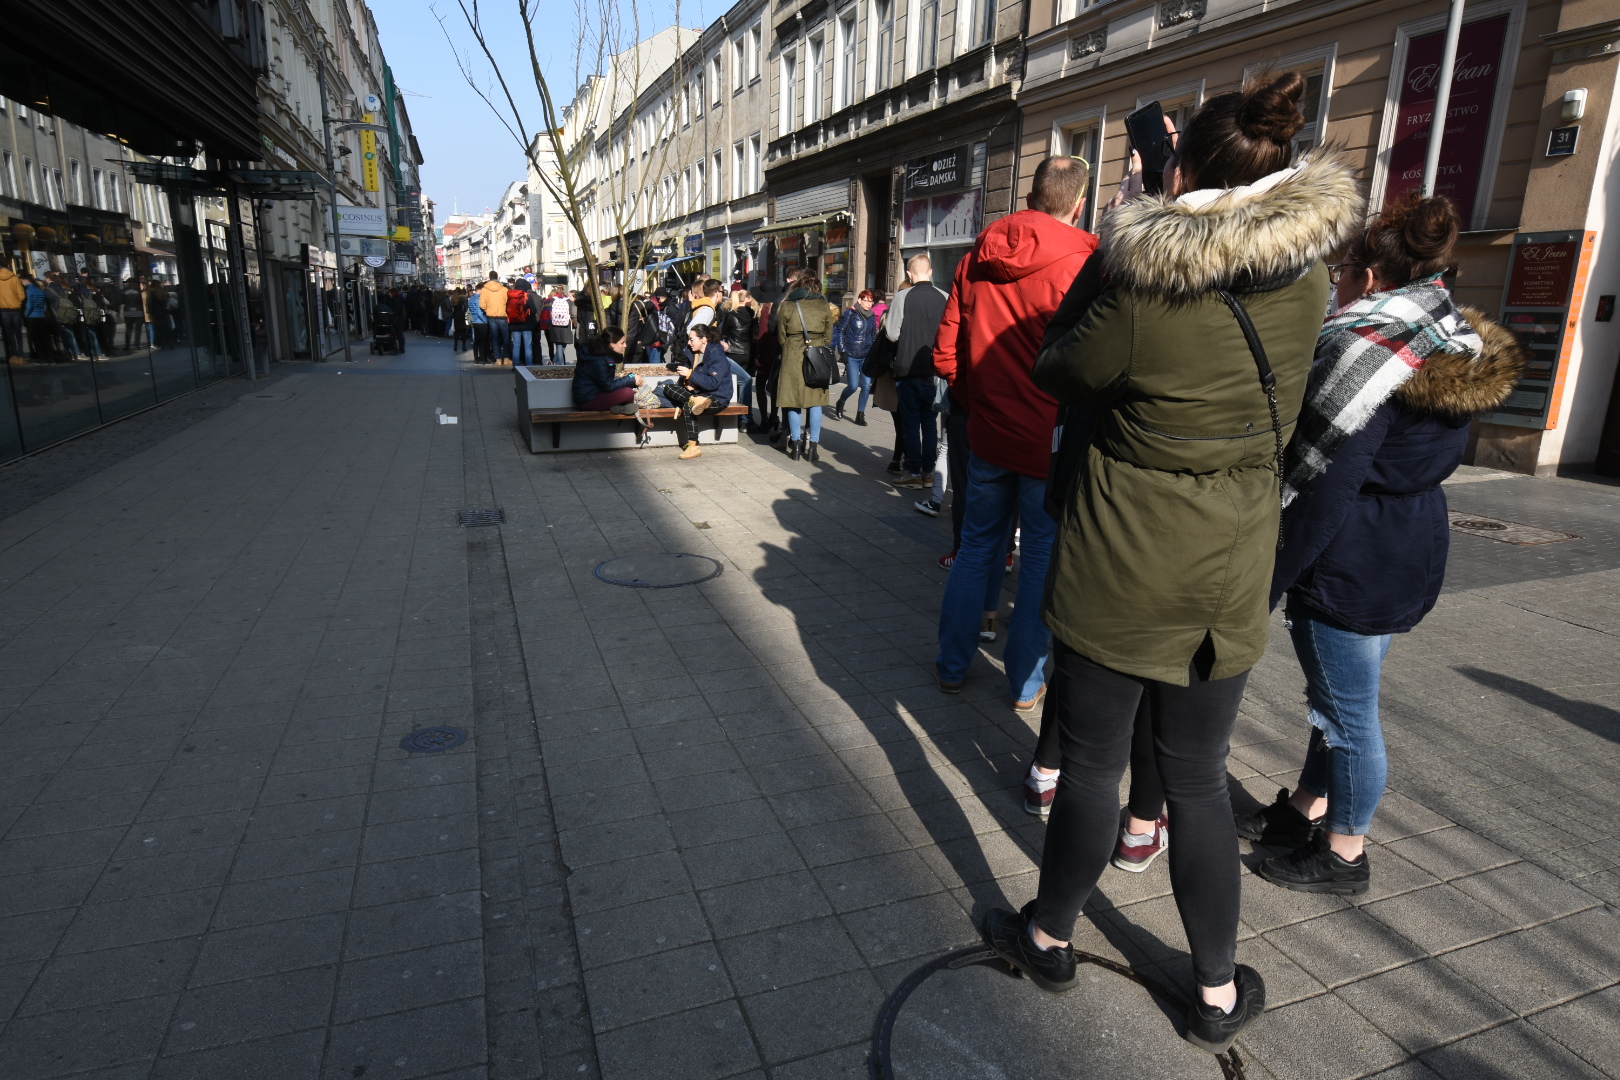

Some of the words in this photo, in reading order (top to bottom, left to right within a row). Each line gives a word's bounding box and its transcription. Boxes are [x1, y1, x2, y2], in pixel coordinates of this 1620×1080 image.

[1406, 104, 1479, 125] FRYZSTWO
[1557, 132, 1570, 143] 31
[932, 153, 957, 172] ODZIEŻ
[929, 170, 957, 187] DAMSKA
[1402, 164, 1463, 180] KOSTYKA
[342, 213, 383, 223] COSINUS
[1521, 246, 1539, 260] El
[1538, 246, 1567, 261] Jean
